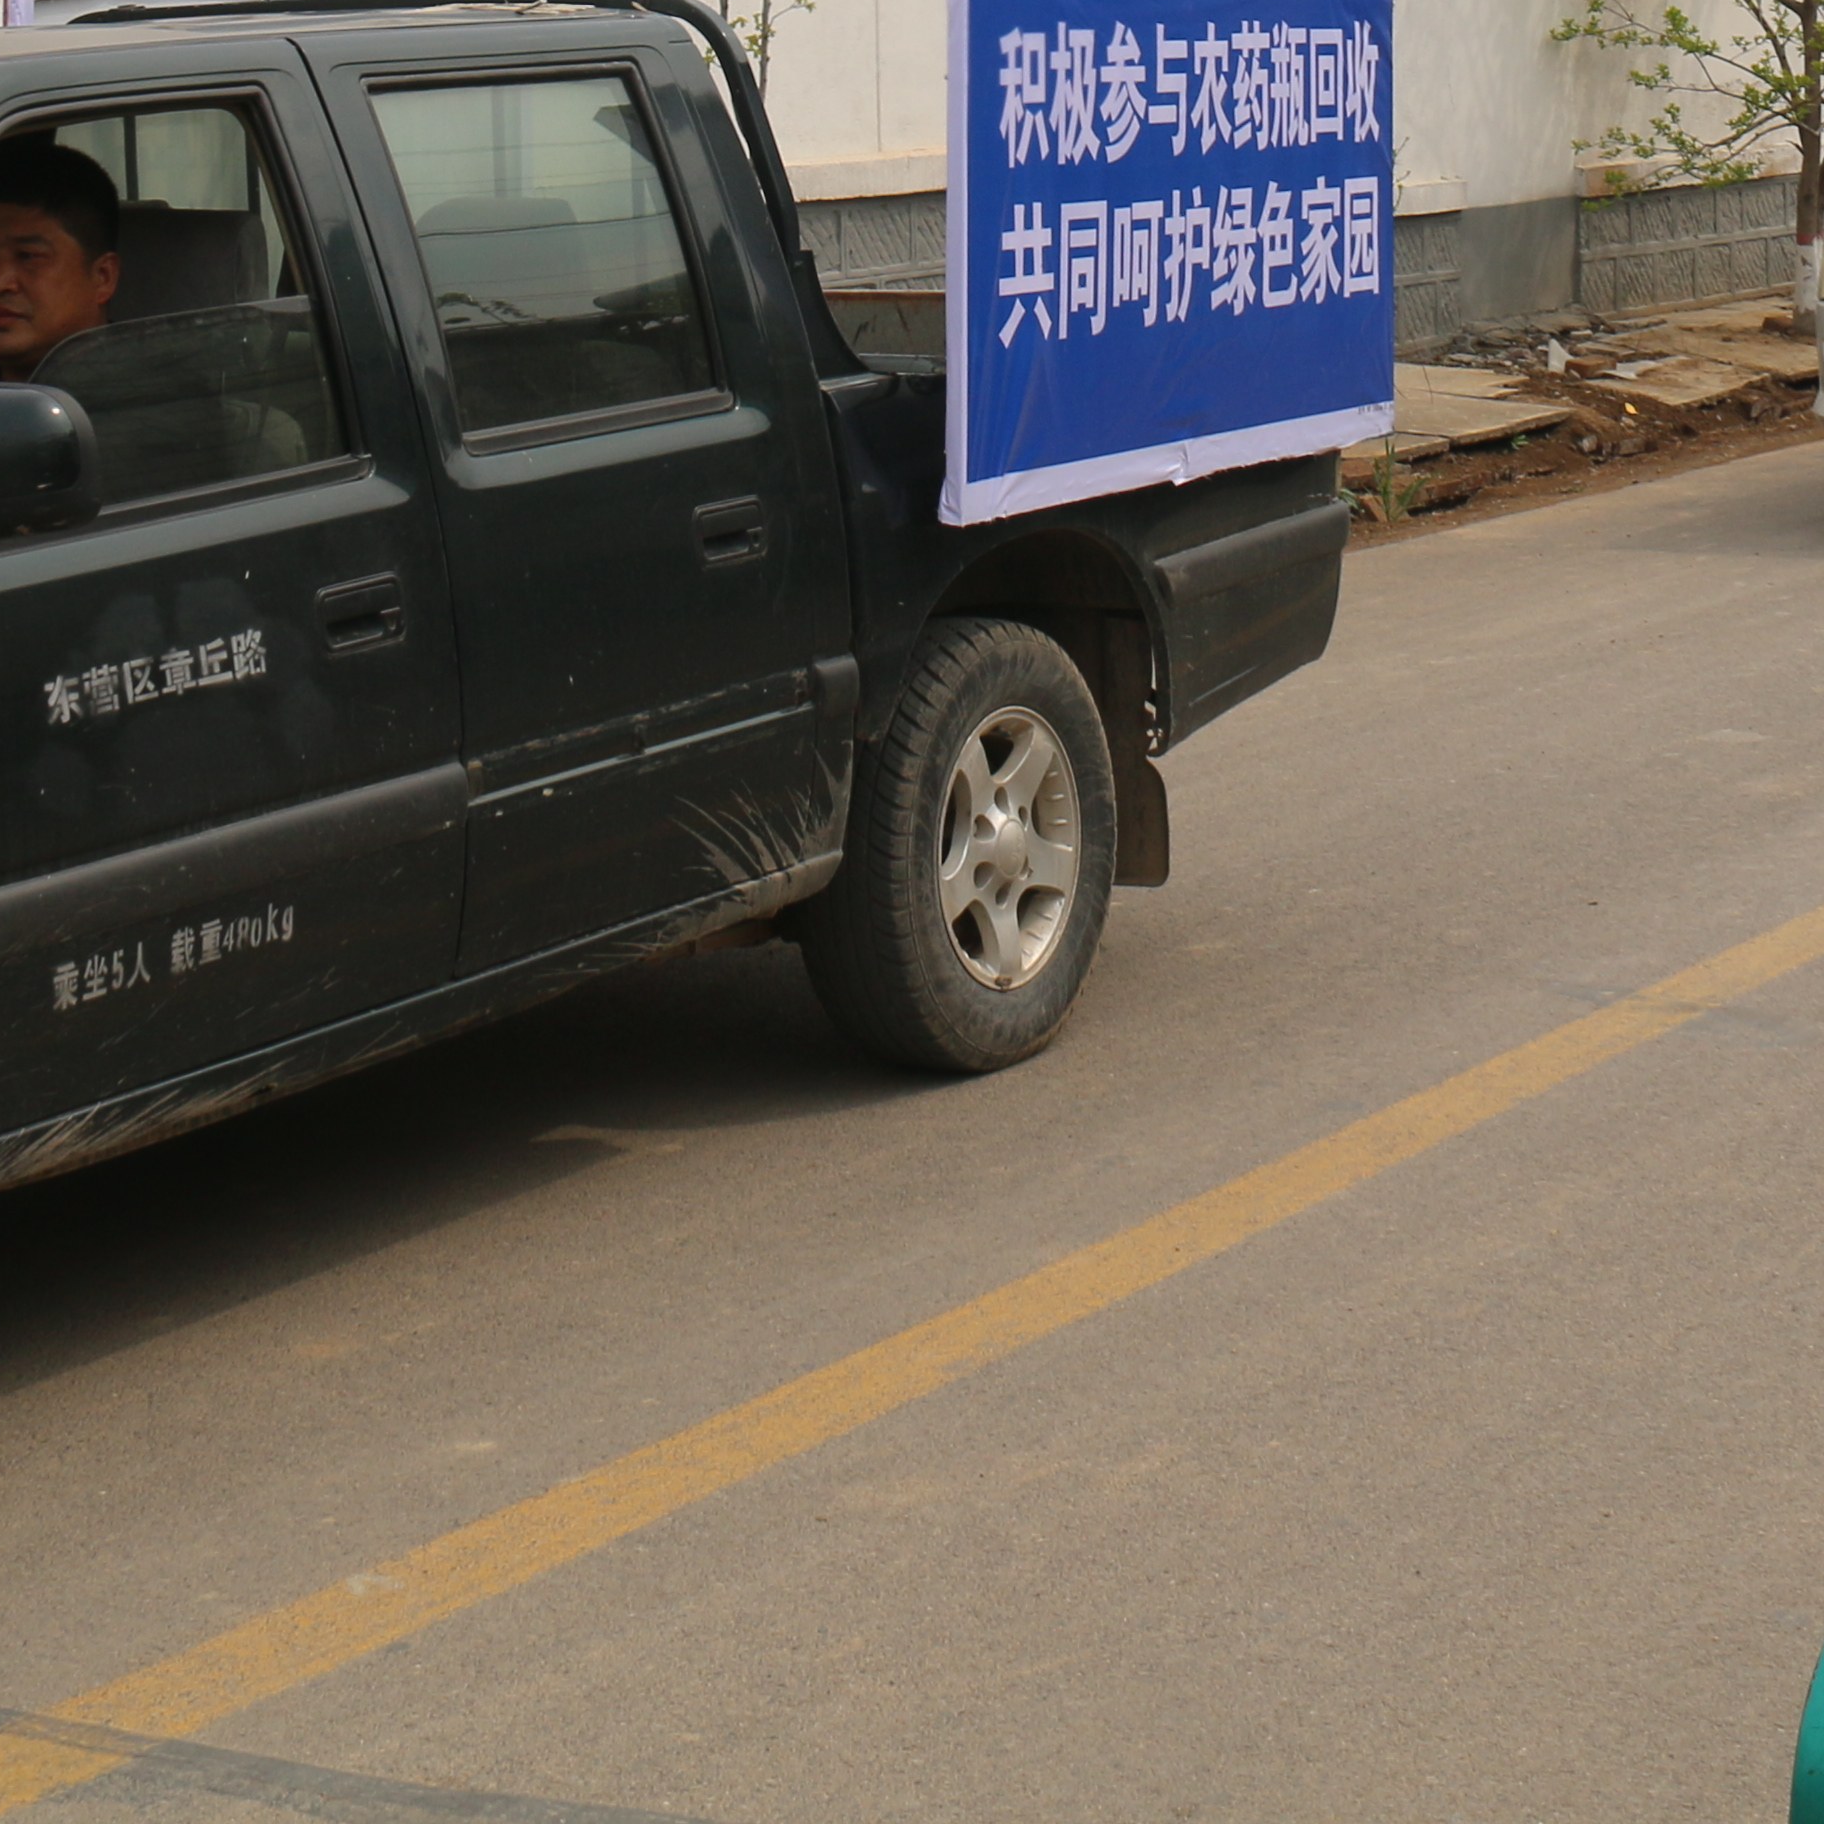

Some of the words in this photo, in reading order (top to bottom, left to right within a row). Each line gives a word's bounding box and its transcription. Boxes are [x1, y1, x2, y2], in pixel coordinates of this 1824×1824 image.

[998, 20, 1380, 168] 积极参与农药瓶回收
[998, 175, 1380, 349] 共同呵护绿色家园
[43, 628, 268, 725] 东营区章丘路
[51, 942, 151, 1011] 乘坐5人
